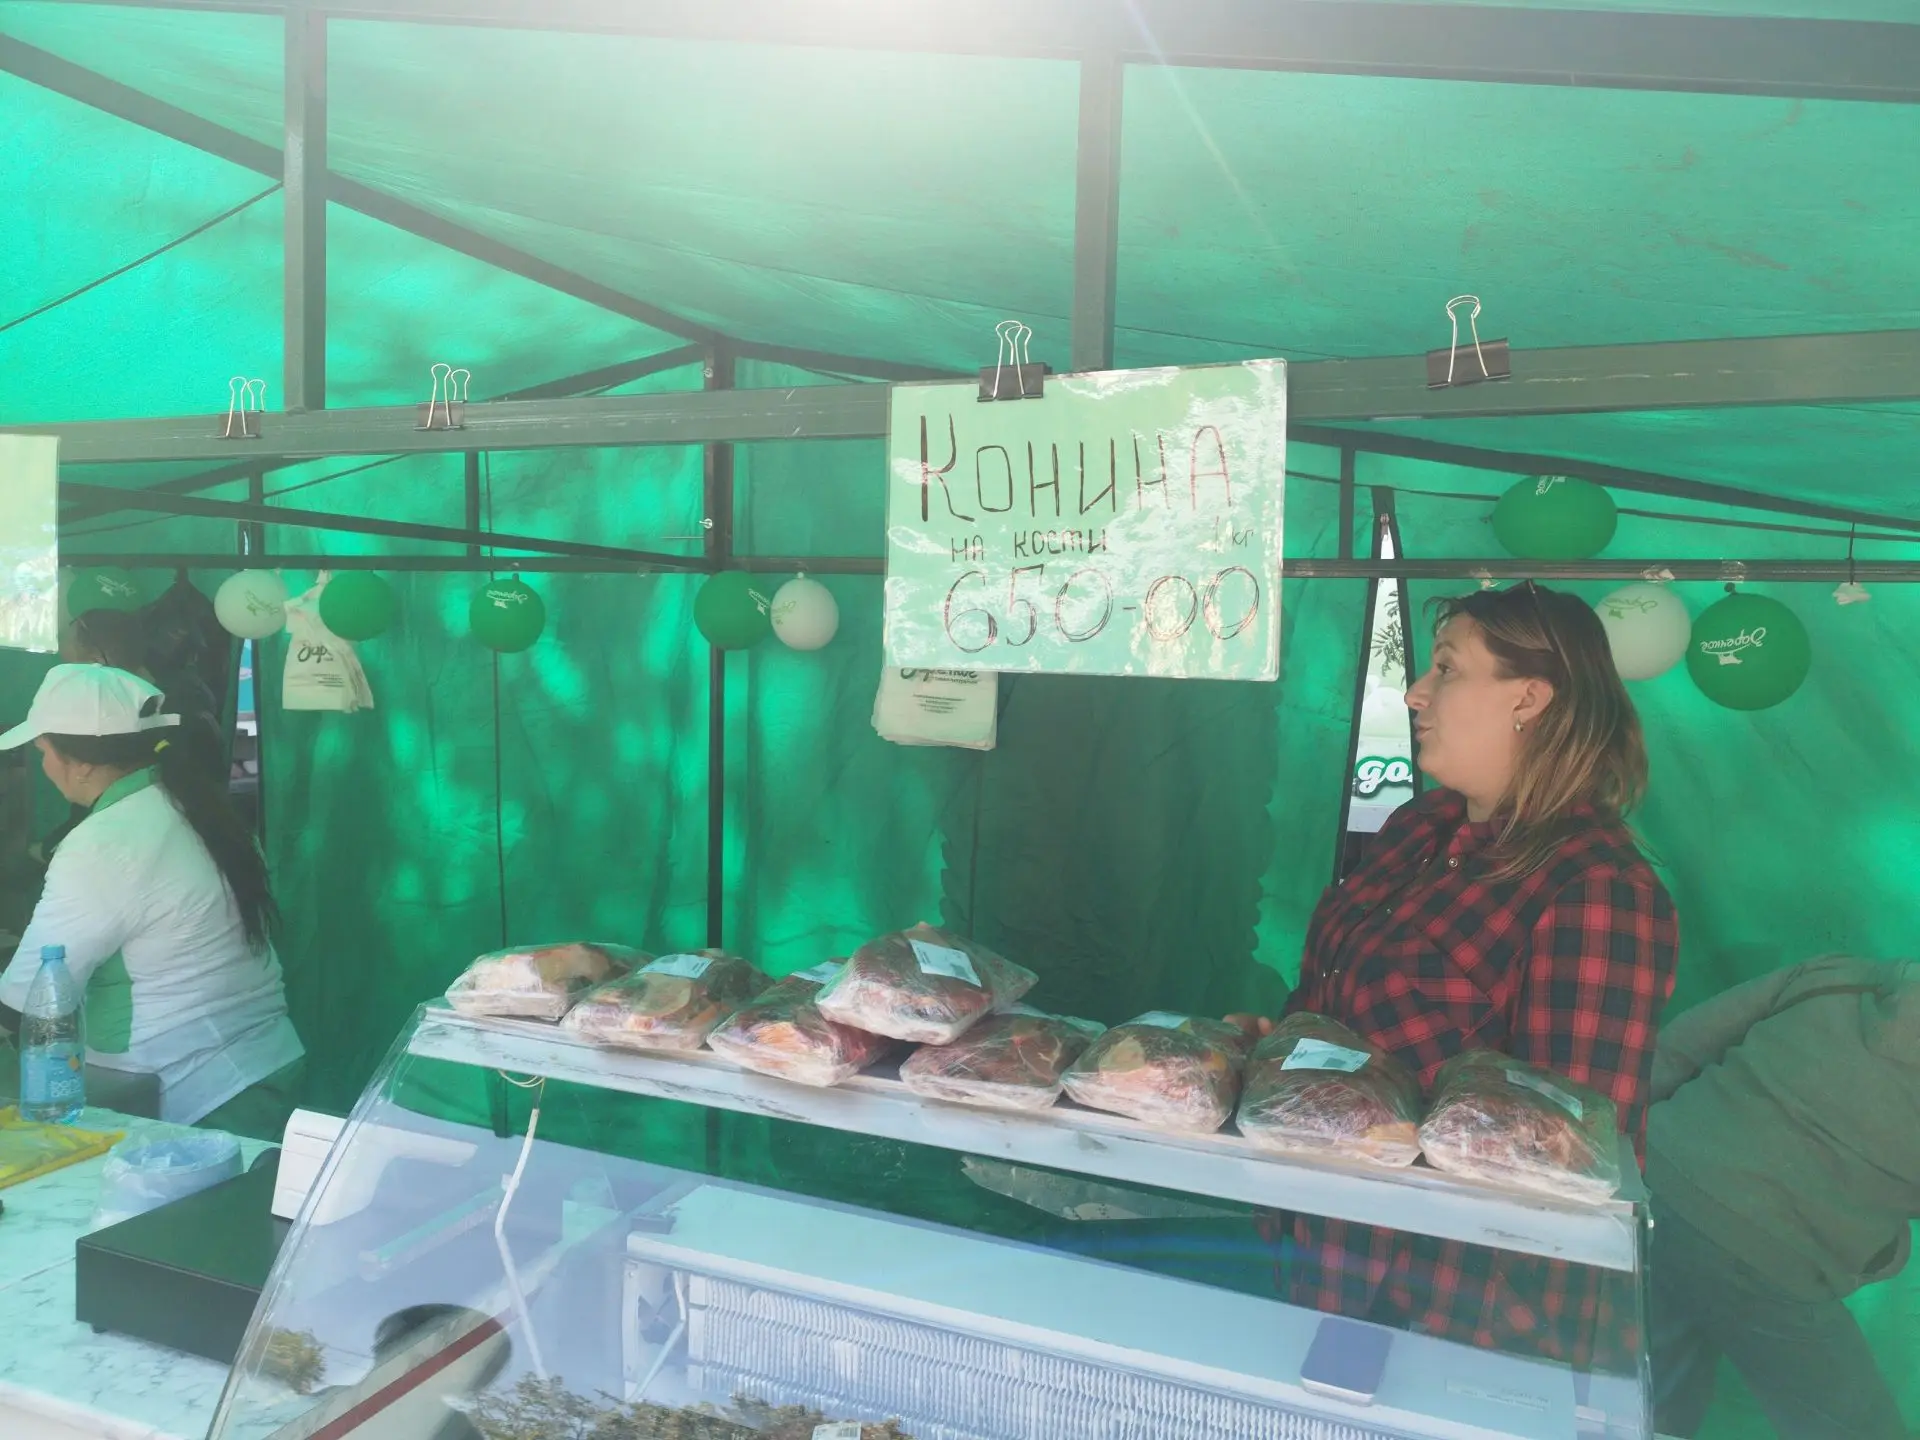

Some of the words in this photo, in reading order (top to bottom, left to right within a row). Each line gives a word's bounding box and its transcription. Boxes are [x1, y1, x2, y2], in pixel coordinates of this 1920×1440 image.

[919, 412, 1233, 523] КОНИНА
[943, 563, 1261, 654] 650-00
[1699, 626, 1768, 653] Заречное
